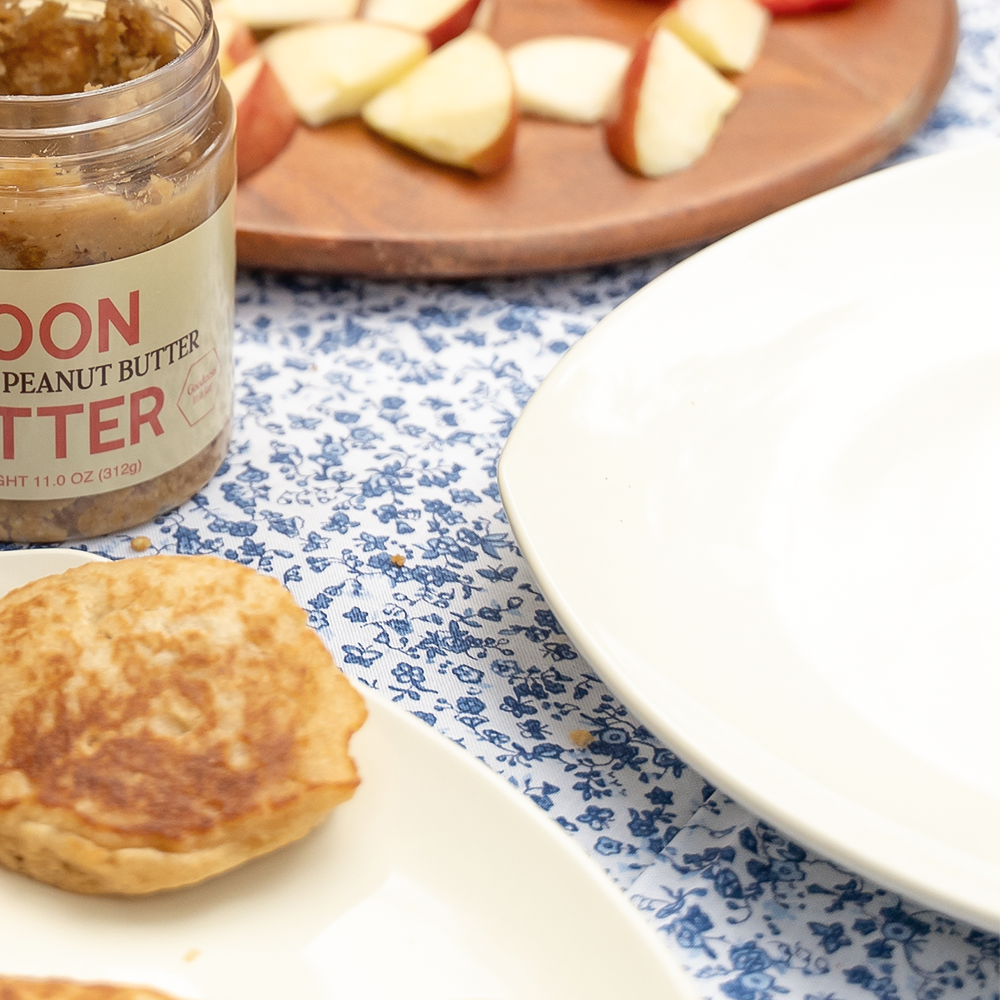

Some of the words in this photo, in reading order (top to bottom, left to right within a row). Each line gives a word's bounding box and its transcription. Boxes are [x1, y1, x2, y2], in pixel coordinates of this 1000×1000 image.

[2, 364, 112, 394] PEANUT
[118, 329, 200, 383] BUTTER
[34, 474, 66, 487] 11.0
[70, 470, 94, 485] OZ
[98, 459, 142, 483] (312g)
